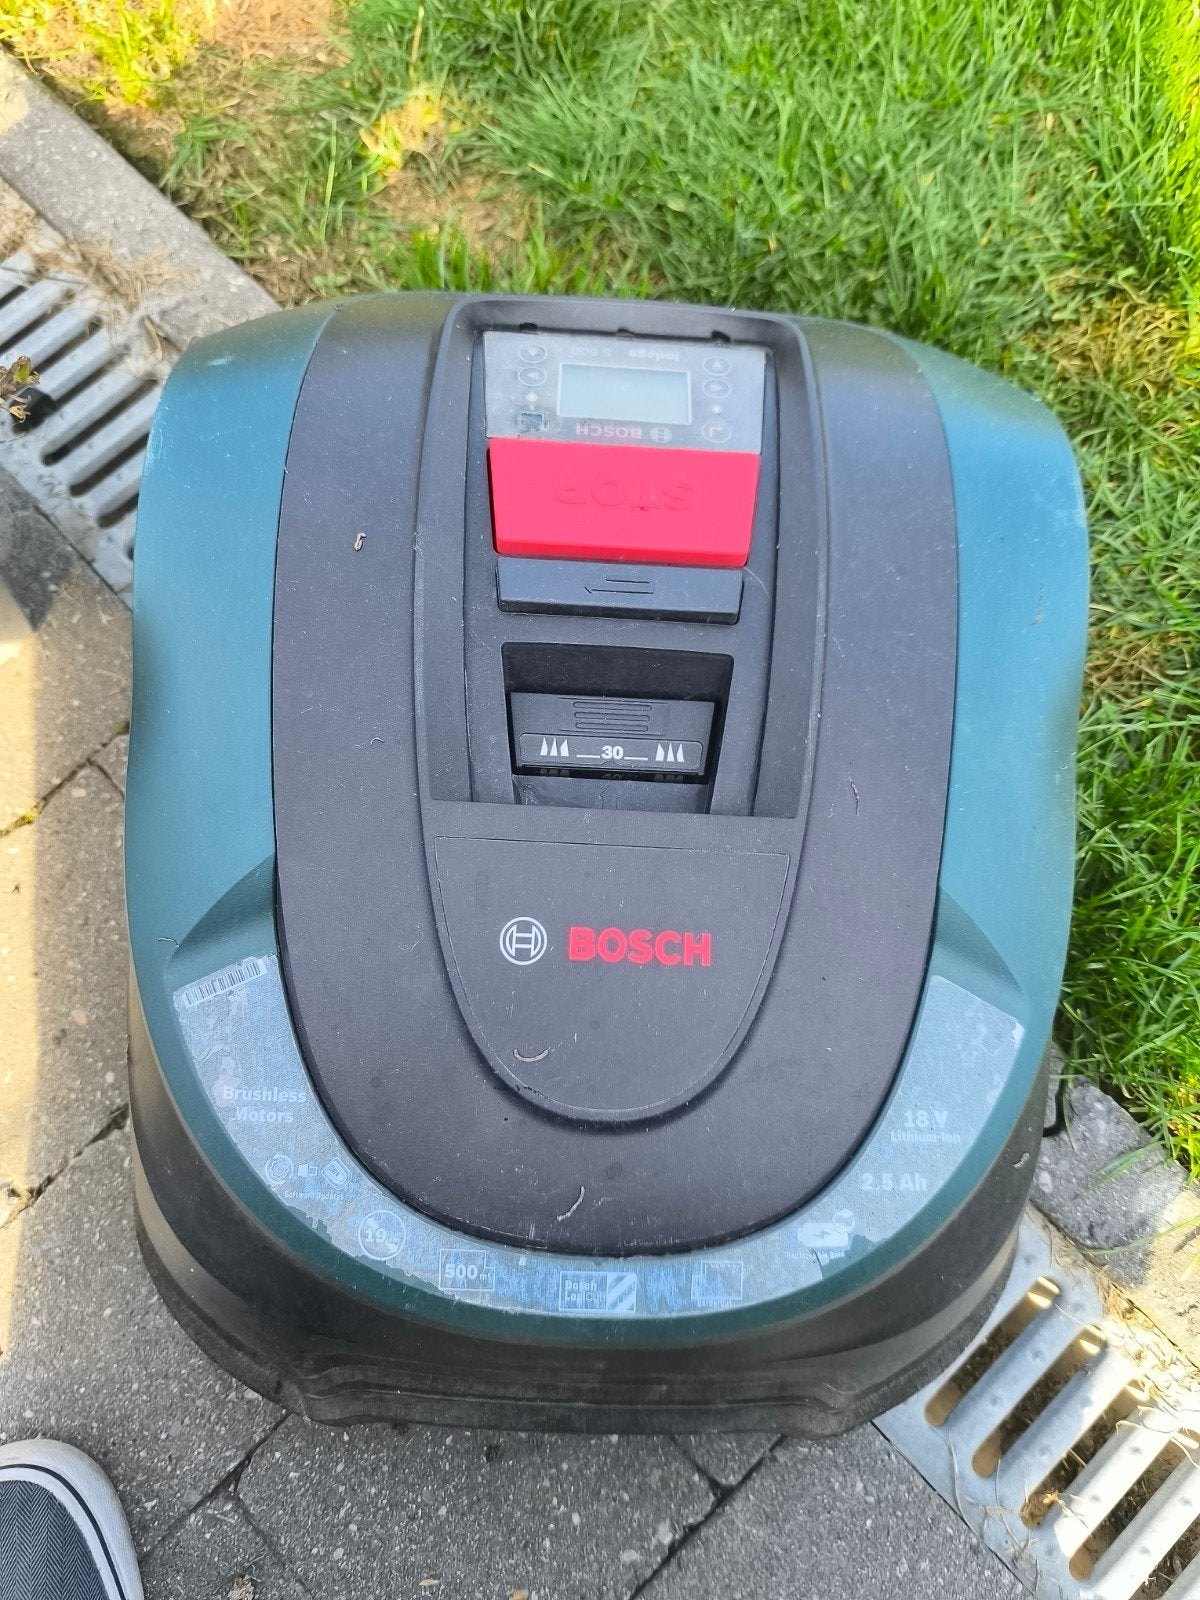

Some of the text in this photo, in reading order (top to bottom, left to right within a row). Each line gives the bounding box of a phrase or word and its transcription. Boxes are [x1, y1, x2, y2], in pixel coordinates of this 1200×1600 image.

[575, 423, 643, 439] BOSCH
[554, 479, 695, 512] STOP
[601, 744, 624, 760] 30
[568, 926, 711, 967] BOSCH
[223, 1086, 307, 1102] Brushless
[235, 1107, 294, 1124] Motors
[904, 1110, 948, 1128] 18 V
[890, 1130, 962, 1143] Lithium-Ion
[861, 1172, 927, 1191] 2.5 Ah
[365, 1227, 387, 1243] 19
[445, 1263, 479, 1280] 500
